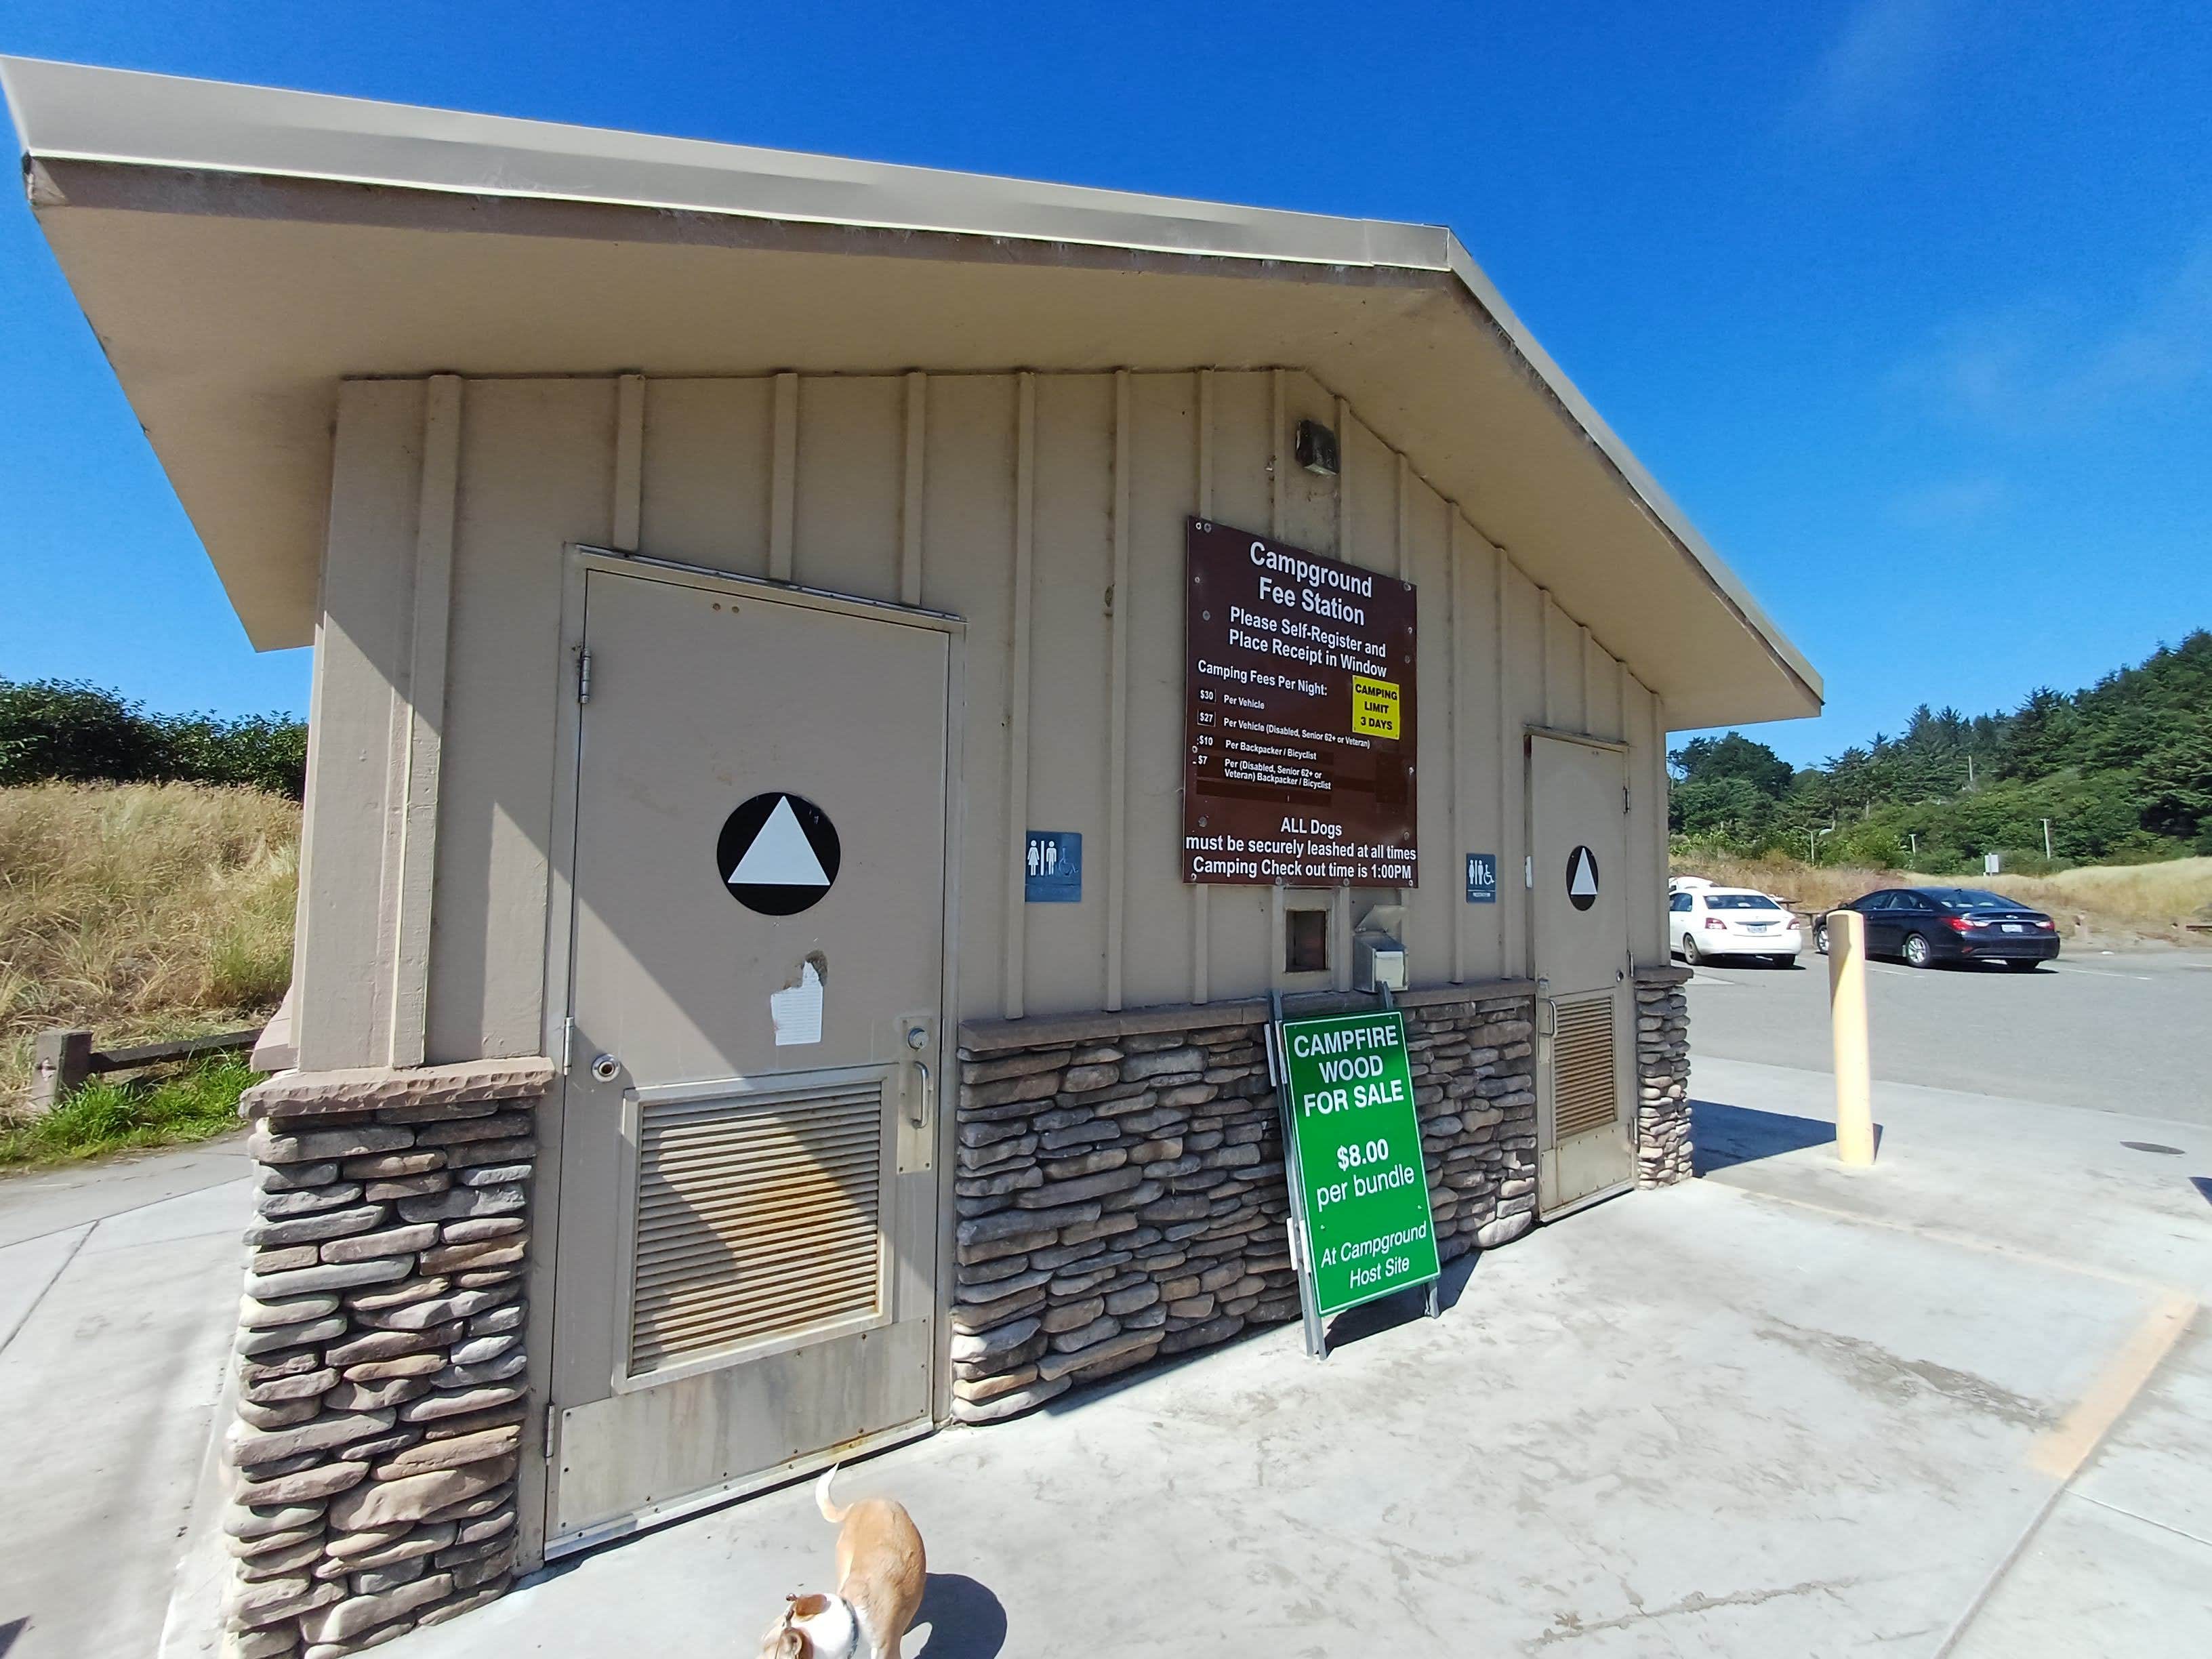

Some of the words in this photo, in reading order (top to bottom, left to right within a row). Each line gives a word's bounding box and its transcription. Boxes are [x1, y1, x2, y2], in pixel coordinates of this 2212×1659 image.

[1250, 541, 1372, 598] Campground
[1260, 577, 1296, 607] Fee
[1302, 589, 1364, 626] Station
[1231, 606, 1277, 632] Please
[1282, 619, 1361, 652] Self-Register
[1365, 642, 1385, 657] and
[1229, 629, 1268, 652] Place
[1273, 638, 1322, 664] Receipt
[1326, 652, 1337, 666] in
[1340, 653, 1387, 678] Window
[1198, 660, 1247, 683] Camping
[1250, 670, 1275, 687] Fees
[1278, 676, 1295, 689] Per
[1298, 680, 1328, 695] Night:
[1355, 684, 1397, 700] CAMPING
[1200, 690, 1213, 700] $30
[1224, 695, 1237, 704] Per
[1239, 697, 1265, 709] Vehicle
[1364, 701, 1389, 714] LIMIT
[1200, 712, 1213, 722] $27
[1224, 718, 1237, 727] Per
[1239, 720, 1264, 731] Vehicle
[1266, 724, 1300, 737] (Disabled,
[1302, 729, 1323, 740] Senior
[1325, 733, 1336, 741] 62+
[1345, 736, 1370, 749] Veteran)
[1361, 717, 1366, 726] 3
[1368, 718, 1393, 730] DAYS
[1200, 735, 1213, 745] $10
[1225, 740, 1238, 750] Per
[1240, 742, 1282, 755] Backpacker
[1288, 749, 1316, 760] Bicyclist
[1198, 755, 1208, 764] $7
[1225, 759, 1237, 768] Per
[1240, 760, 1275, 773] (Disabled,
[1277, 766, 1300, 775] Senior
[1225, 769, 1255, 781] Veteran)
[1257, 773, 1298, 785] Backpacker
[1303, 779, 1331, 789] Bicyclist
[1281, 817, 1307, 834] ALL
[1311, 820, 1342, 839] Dogs
[1186, 835, 1223, 851] must
[1227, 836, 1244, 852] be
[1248, 841, 1304, 858] securely
[1308, 840, 1354, 857] leashed
[1357, 846, 1368, 858] at
[1371, 845, 1383, 859] all
[1387, 846, 1416, 860] times
[1193, 857, 1257, 878] Camping
[1261, 859, 1301, 876] Check
[1305, 862, 1326, 876] out
[1329, 863, 1354, 878] time
[1357, 864, 1368, 878] is
[1371, 865, 1411, 879] 1:00PM
[1294, 1025, 1398, 1057] CAMPFIRE
[1319, 1055, 1382, 1083] WOOD
[1303, 1090, 1349, 1117] FOR
[1355, 1080, 1404, 1108] SALE
[1336, 1139, 1389, 1171] $8.00
[1317, 1182, 1347, 1212] per
[1353, 1164, 1414, 1197] bundle
[1321, 1247, 1336, 1268] At
[1341, 1221, 1427, 1263] Campground
[1350, 1263, 1382, 1288] Host
[1385, 1256, 1410, 1277] Site
